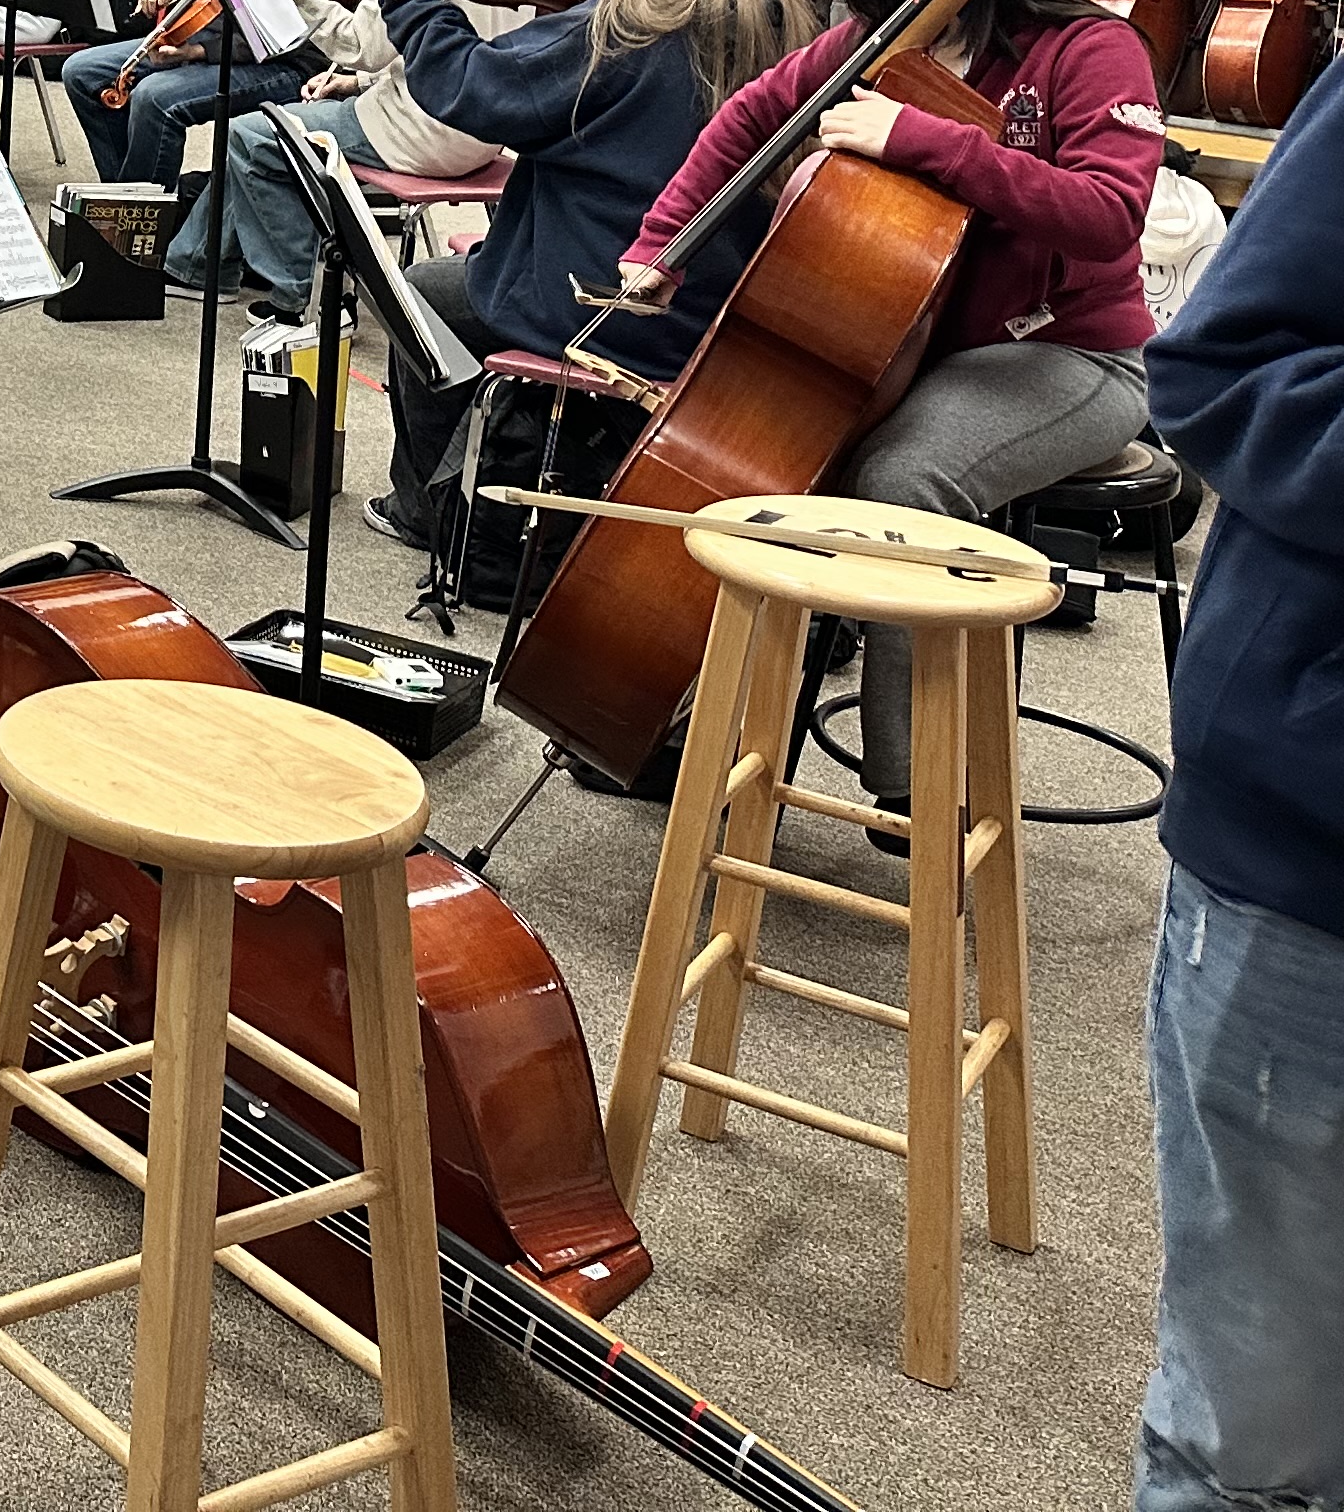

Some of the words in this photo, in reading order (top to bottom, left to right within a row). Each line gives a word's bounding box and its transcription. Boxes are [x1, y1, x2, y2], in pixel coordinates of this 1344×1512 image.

[85, 204, 142, 218] Essentials
[144, 205, 162, 219] for
[117, 218, 159, 233] Strings
